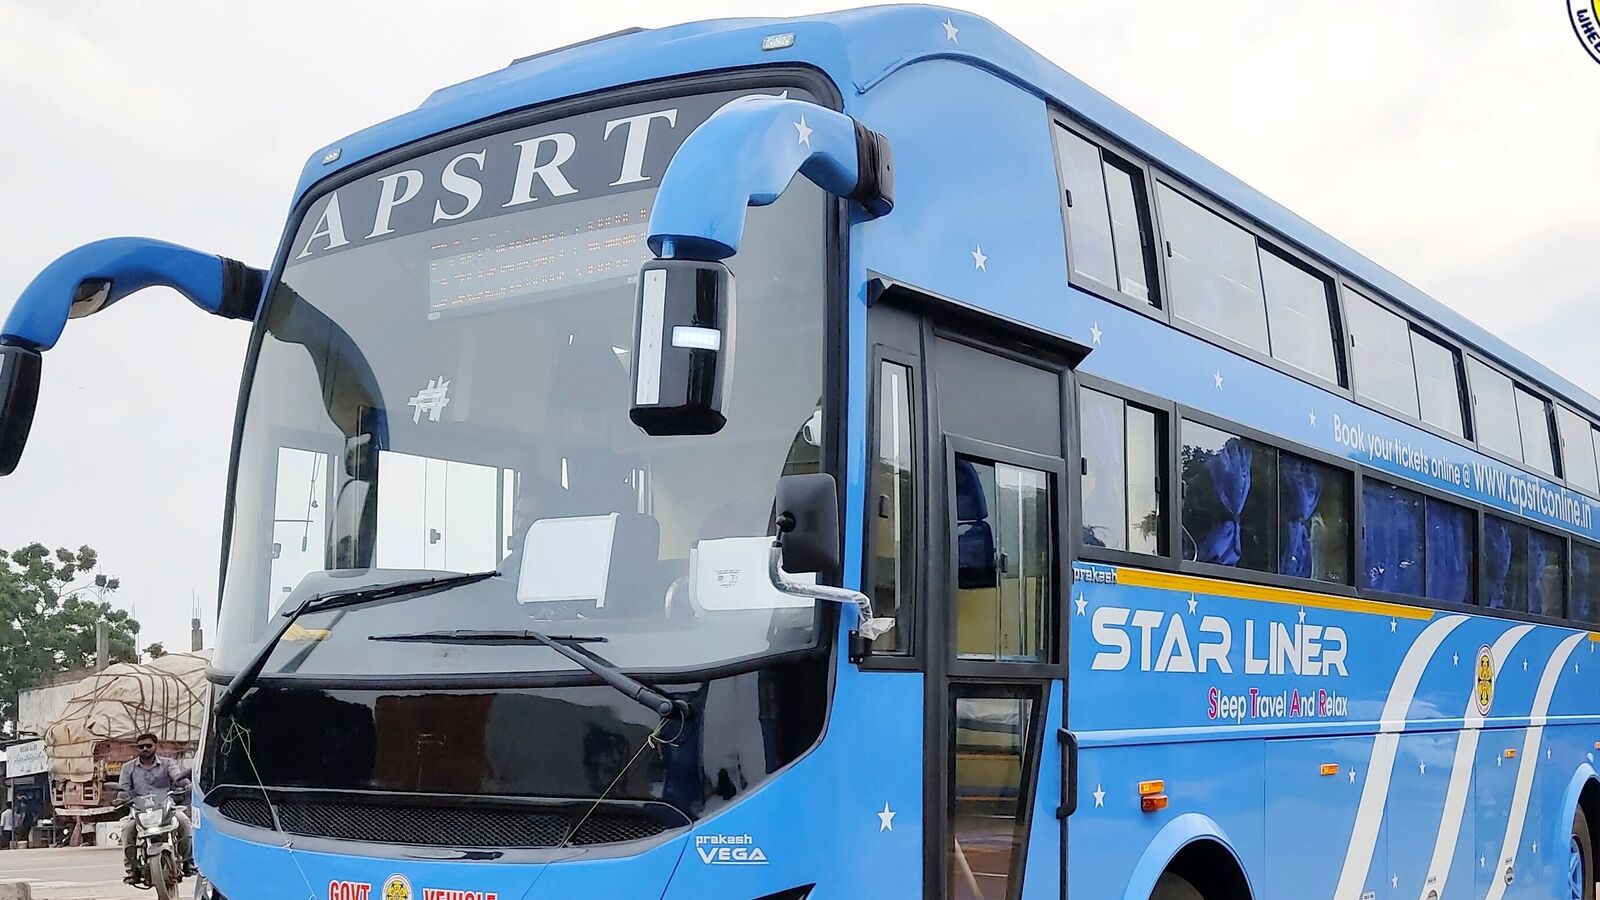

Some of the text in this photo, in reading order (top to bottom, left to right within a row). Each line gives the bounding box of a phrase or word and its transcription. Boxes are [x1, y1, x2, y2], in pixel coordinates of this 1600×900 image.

[296, 90, 789, 259] APSRT
[1333, 414, 1592, 529] Book your tickets online @ www.apsrtconline.in
[1073, 566, 1117, 584] prakash
[1091, 606, 1350, 676] STAR LINER
[1208, 686, 1348, 724] Sleep Travel And Relax
[695, 833, 753, 847] prakash
[696, 848, 767, 864] VEGA
